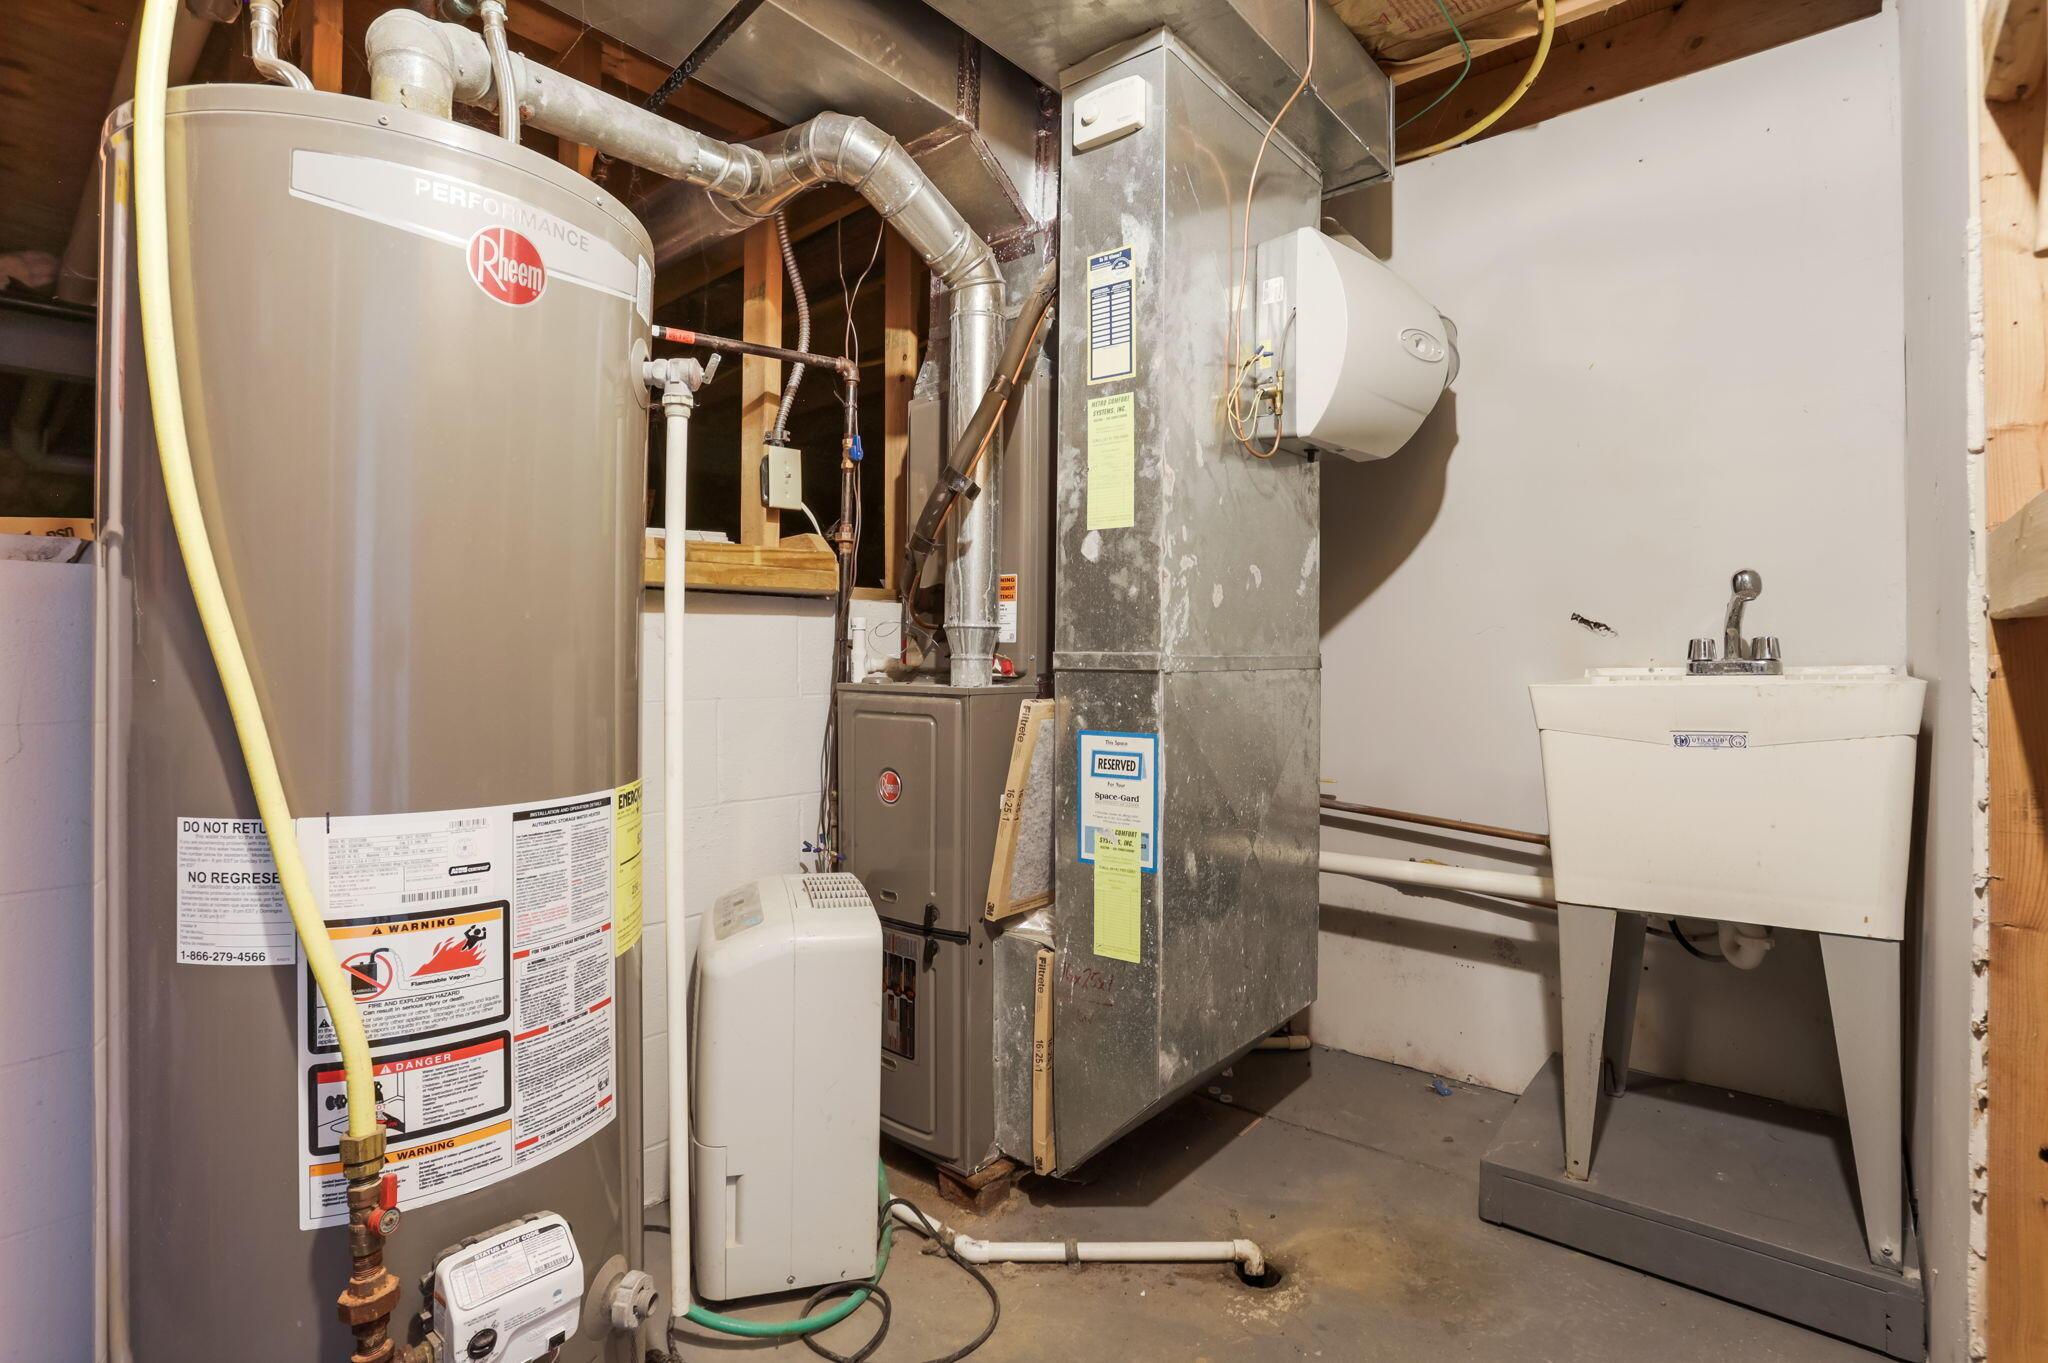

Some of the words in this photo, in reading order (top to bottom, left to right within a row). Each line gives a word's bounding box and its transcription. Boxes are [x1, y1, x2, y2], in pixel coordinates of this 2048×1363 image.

[415, 177, 590, 252] PERFORMANCE
[478, 228, 543, 292] Rheem
[1108, 395, 1130, 405] COMFORT
[1017, 705, 1031, 743] Filtrete
[1098, 758, 1136, 772] RESERVED
[529, 808, 560, 818] INSTALLATION
[570, 804, 589, 812] OPERATION
[183, 821, 200, 832] DO
[203, 822, 228, 833] NOT
[232, 822, 266, 834] RETU
[532, 820, 558, 828] AUTOMATIC
[558, 816, 576, 824] STORAGE
[1115, 829, 1137, 837] COMFORT
[188, 871, 206, 883] NO
[211, 872, 281, 884] REGRESE
[986, 902, 995, 916] 3M
[388, 917, 456, 933] WARNING
[574, 934, 586, 942] BEFORE
[180, 951, 266, 962] 1-866-279-4566
[411, 976, 447, 987] Flammable
[448, 972, 471, 981] Vapors
[1037, 956, 1047, 993] Filtrete
[399, 995, 434, 1005] EXPLOSION
[435, 990, 460, 999] HAZARD
[376, 1007, 394, 1015] result
[402, 1003, 423, 1011] serious
[425, 1000, 440, 1009] injury
[395, 1053, 452, 1072] DANGER
[396, 1140, 455, 1160] WARNING
[1035, 1156, 1043, 1170] 3M
[474, 1245, 501, 1261] STATUS
[500, 1237, 521, 1250] LIGHT
[520, 1229, 540, 1241] CODE
